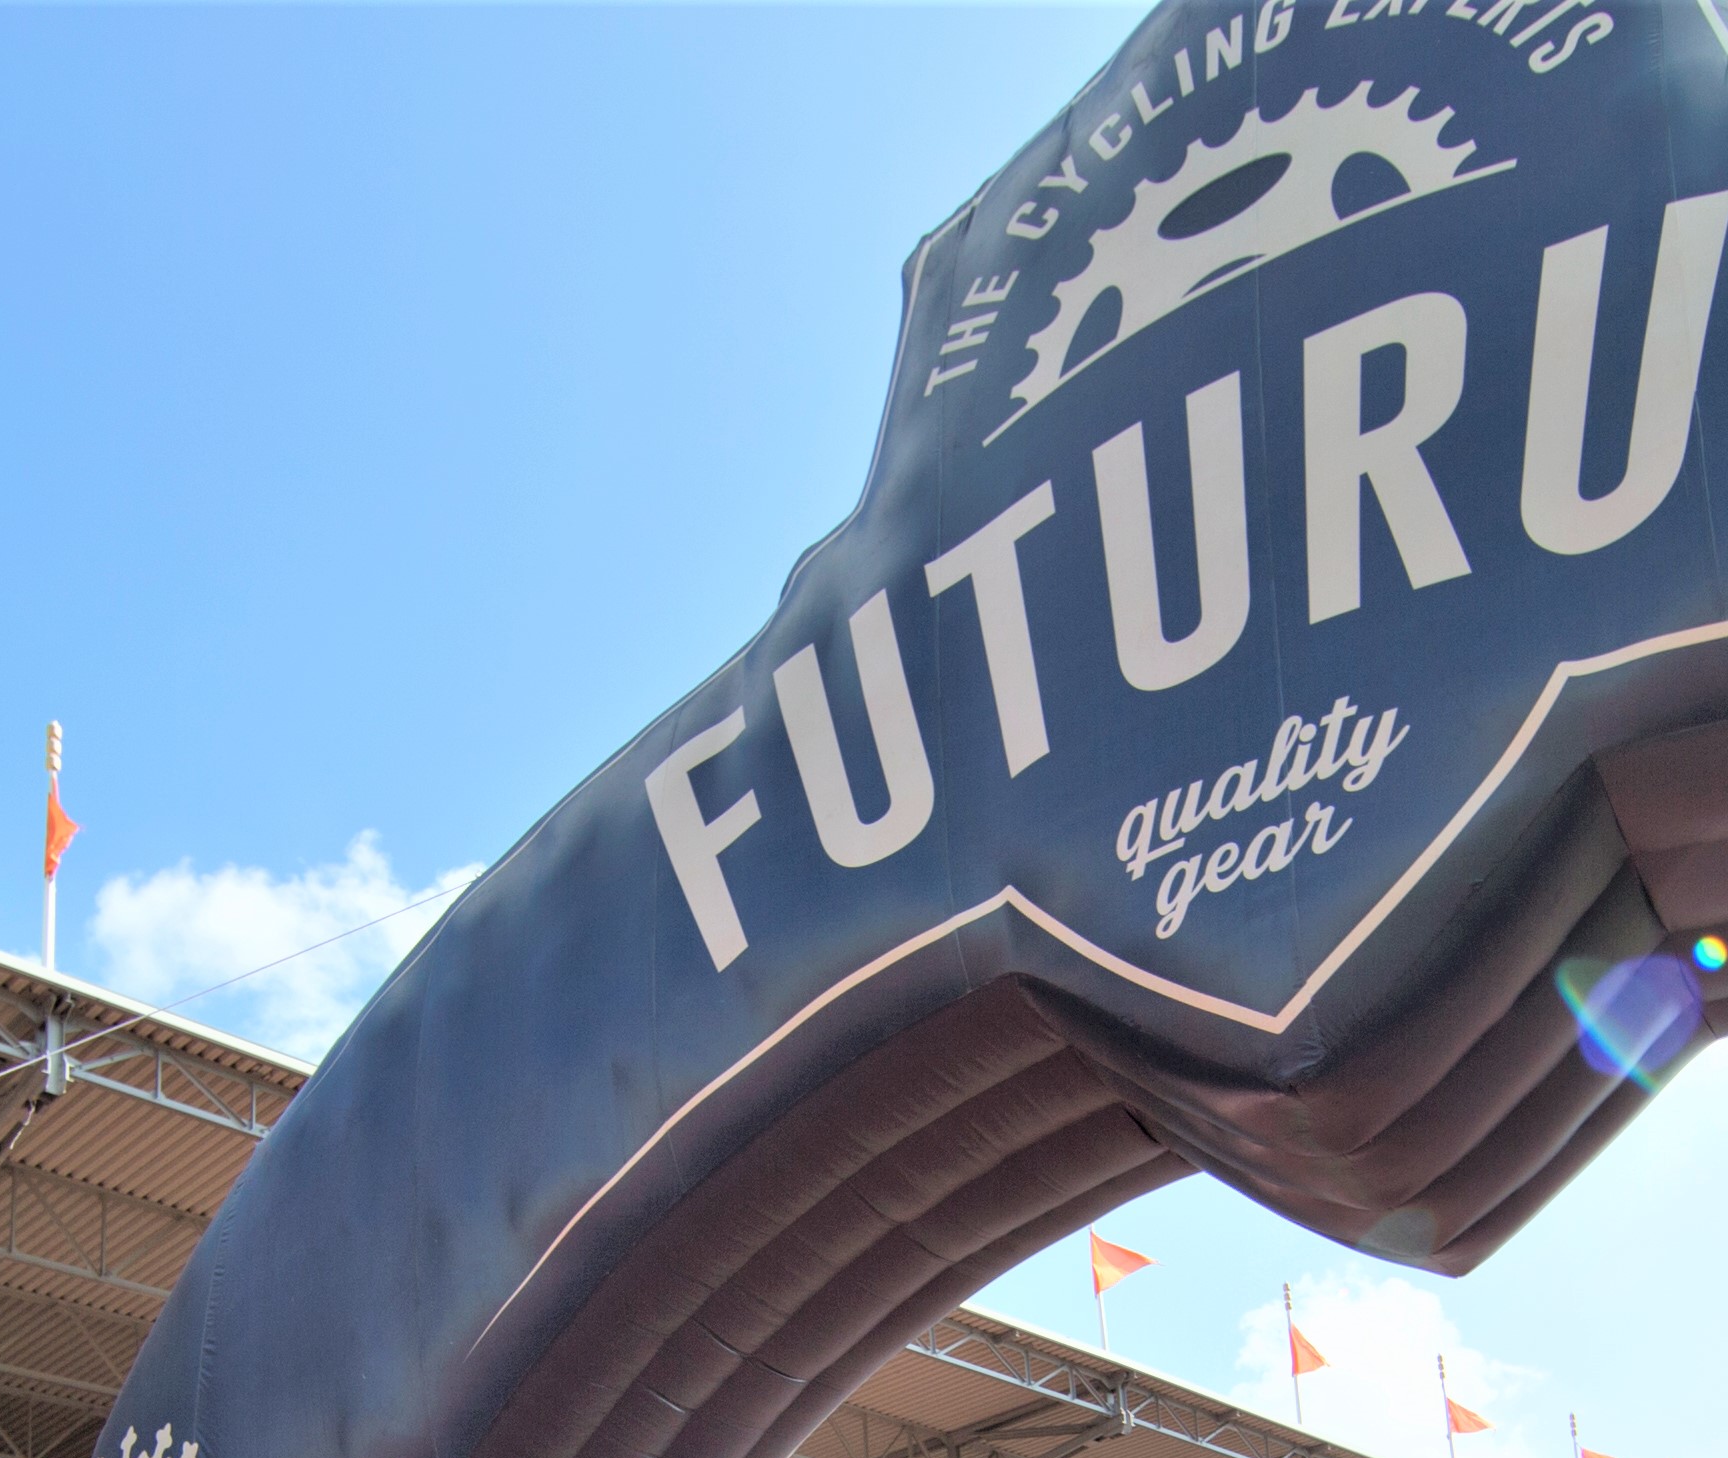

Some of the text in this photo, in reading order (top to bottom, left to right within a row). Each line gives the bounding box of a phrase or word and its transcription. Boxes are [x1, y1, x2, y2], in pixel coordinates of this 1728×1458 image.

[924, 0, 1614, 397] THE CYCLING ERTS
[1116, 695, 1410, 881] quality
[1156, 801, 1353, 940] gear
